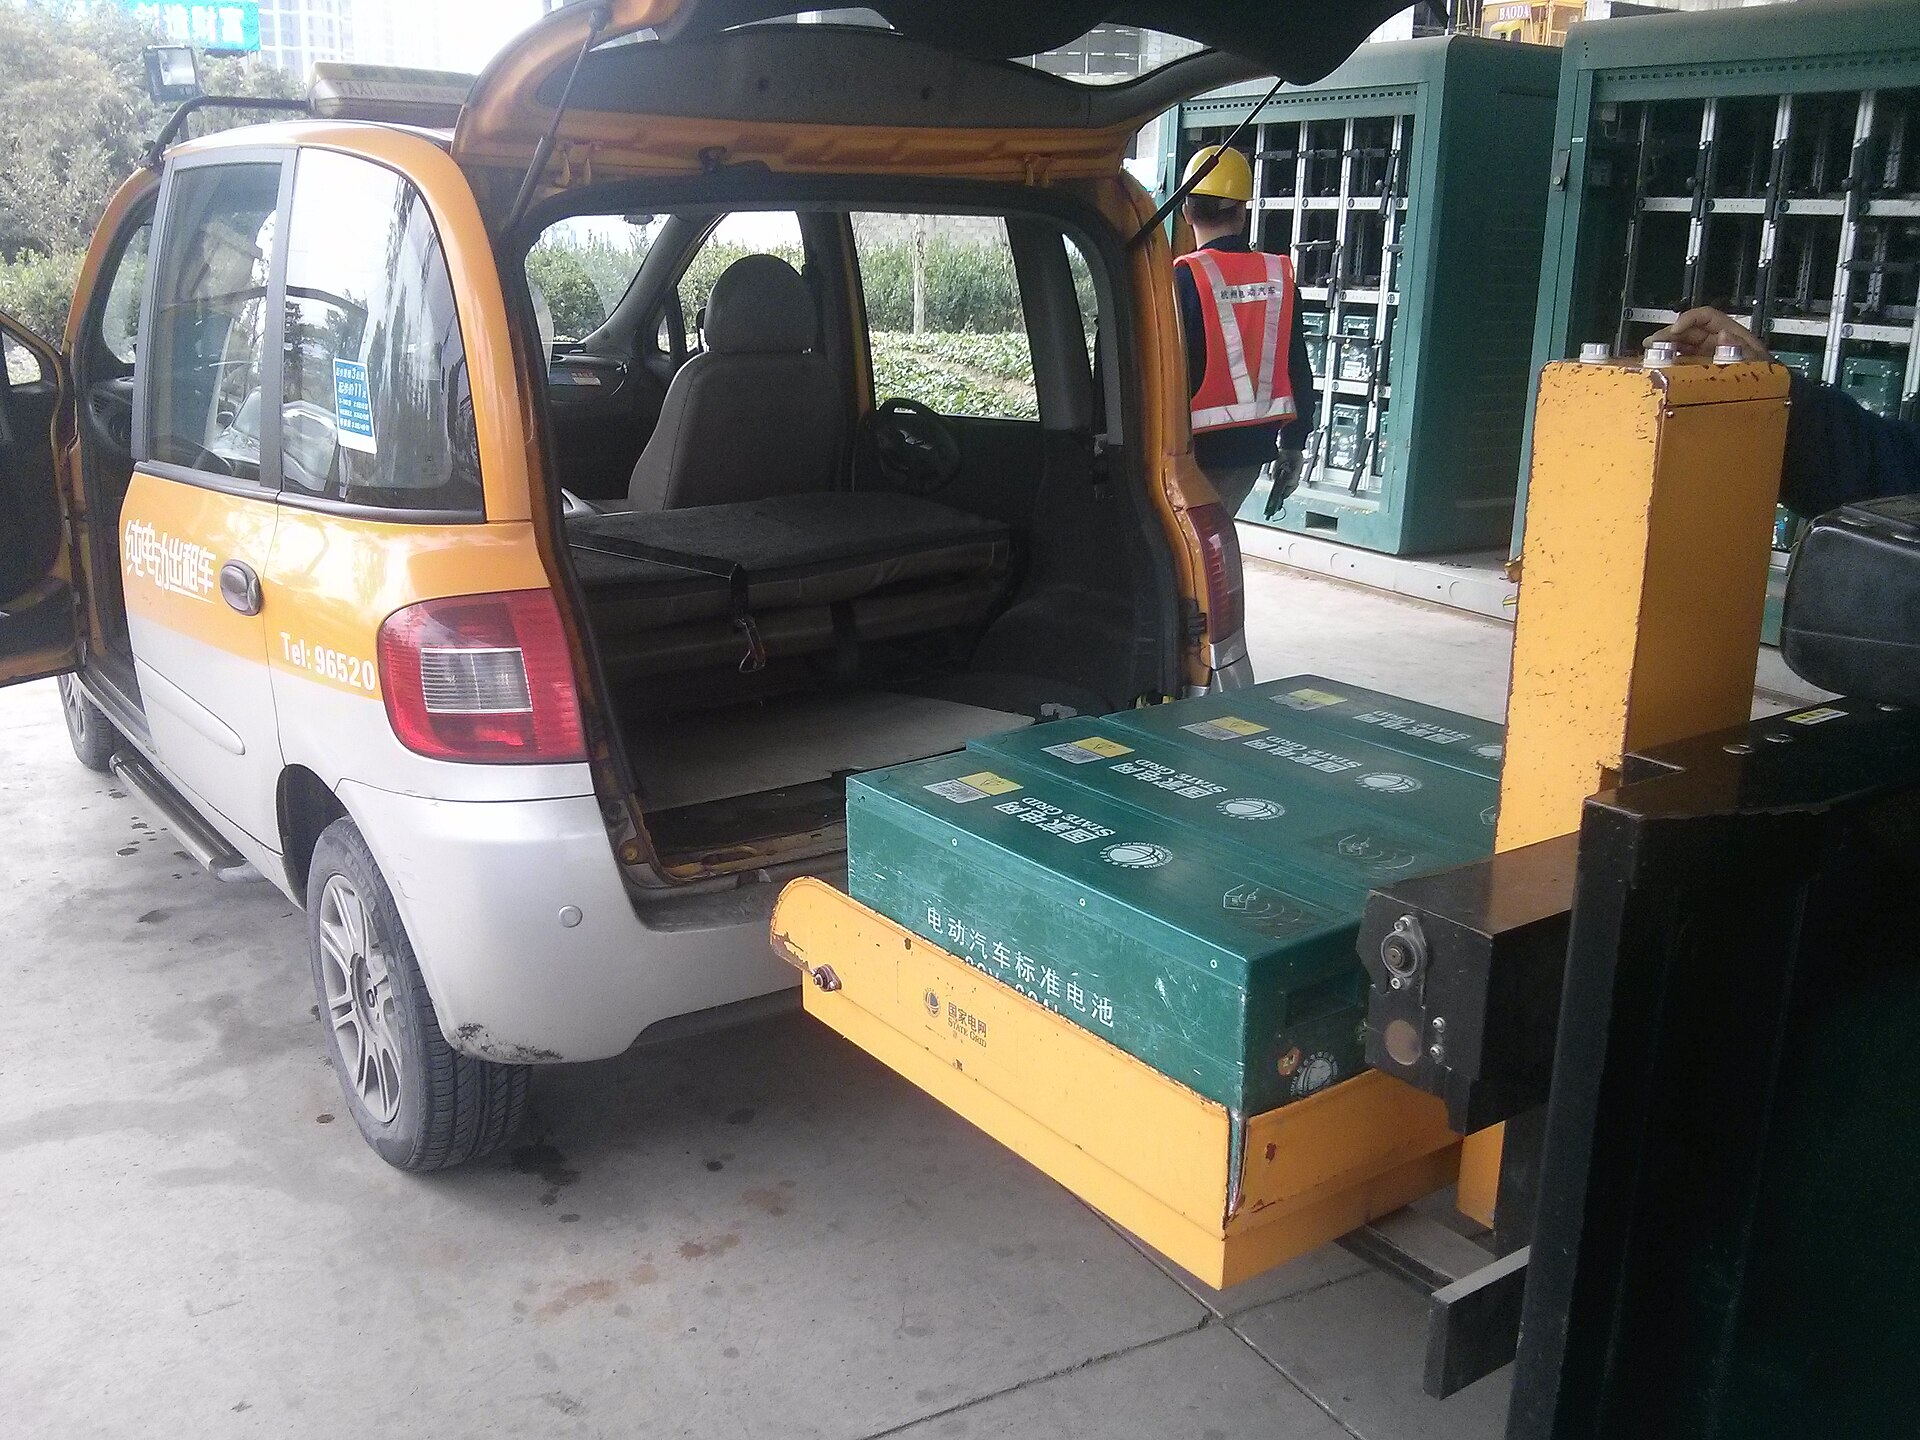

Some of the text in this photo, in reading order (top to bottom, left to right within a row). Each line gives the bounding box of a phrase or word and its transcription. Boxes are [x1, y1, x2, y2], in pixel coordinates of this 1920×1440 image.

[1500, 4, 1530, 20] BAODA
[336, 80, 376, 97] TAXI
[125, 519, 216, 596] 纯电动出租车
[280, 631, 375, 690] Tel: 96520
[1352, 713, 1458, 744] 国家电网
[1242, 738, 1348, 773] 国家电网
[1109, 762, 1213, 799] 国家电网
[993, 801, 1100, 844] 国家电网
[927, 906, 1114, 1028] 电动汽车标准电池
[948, 1002, 986, 1038] 国家电网
